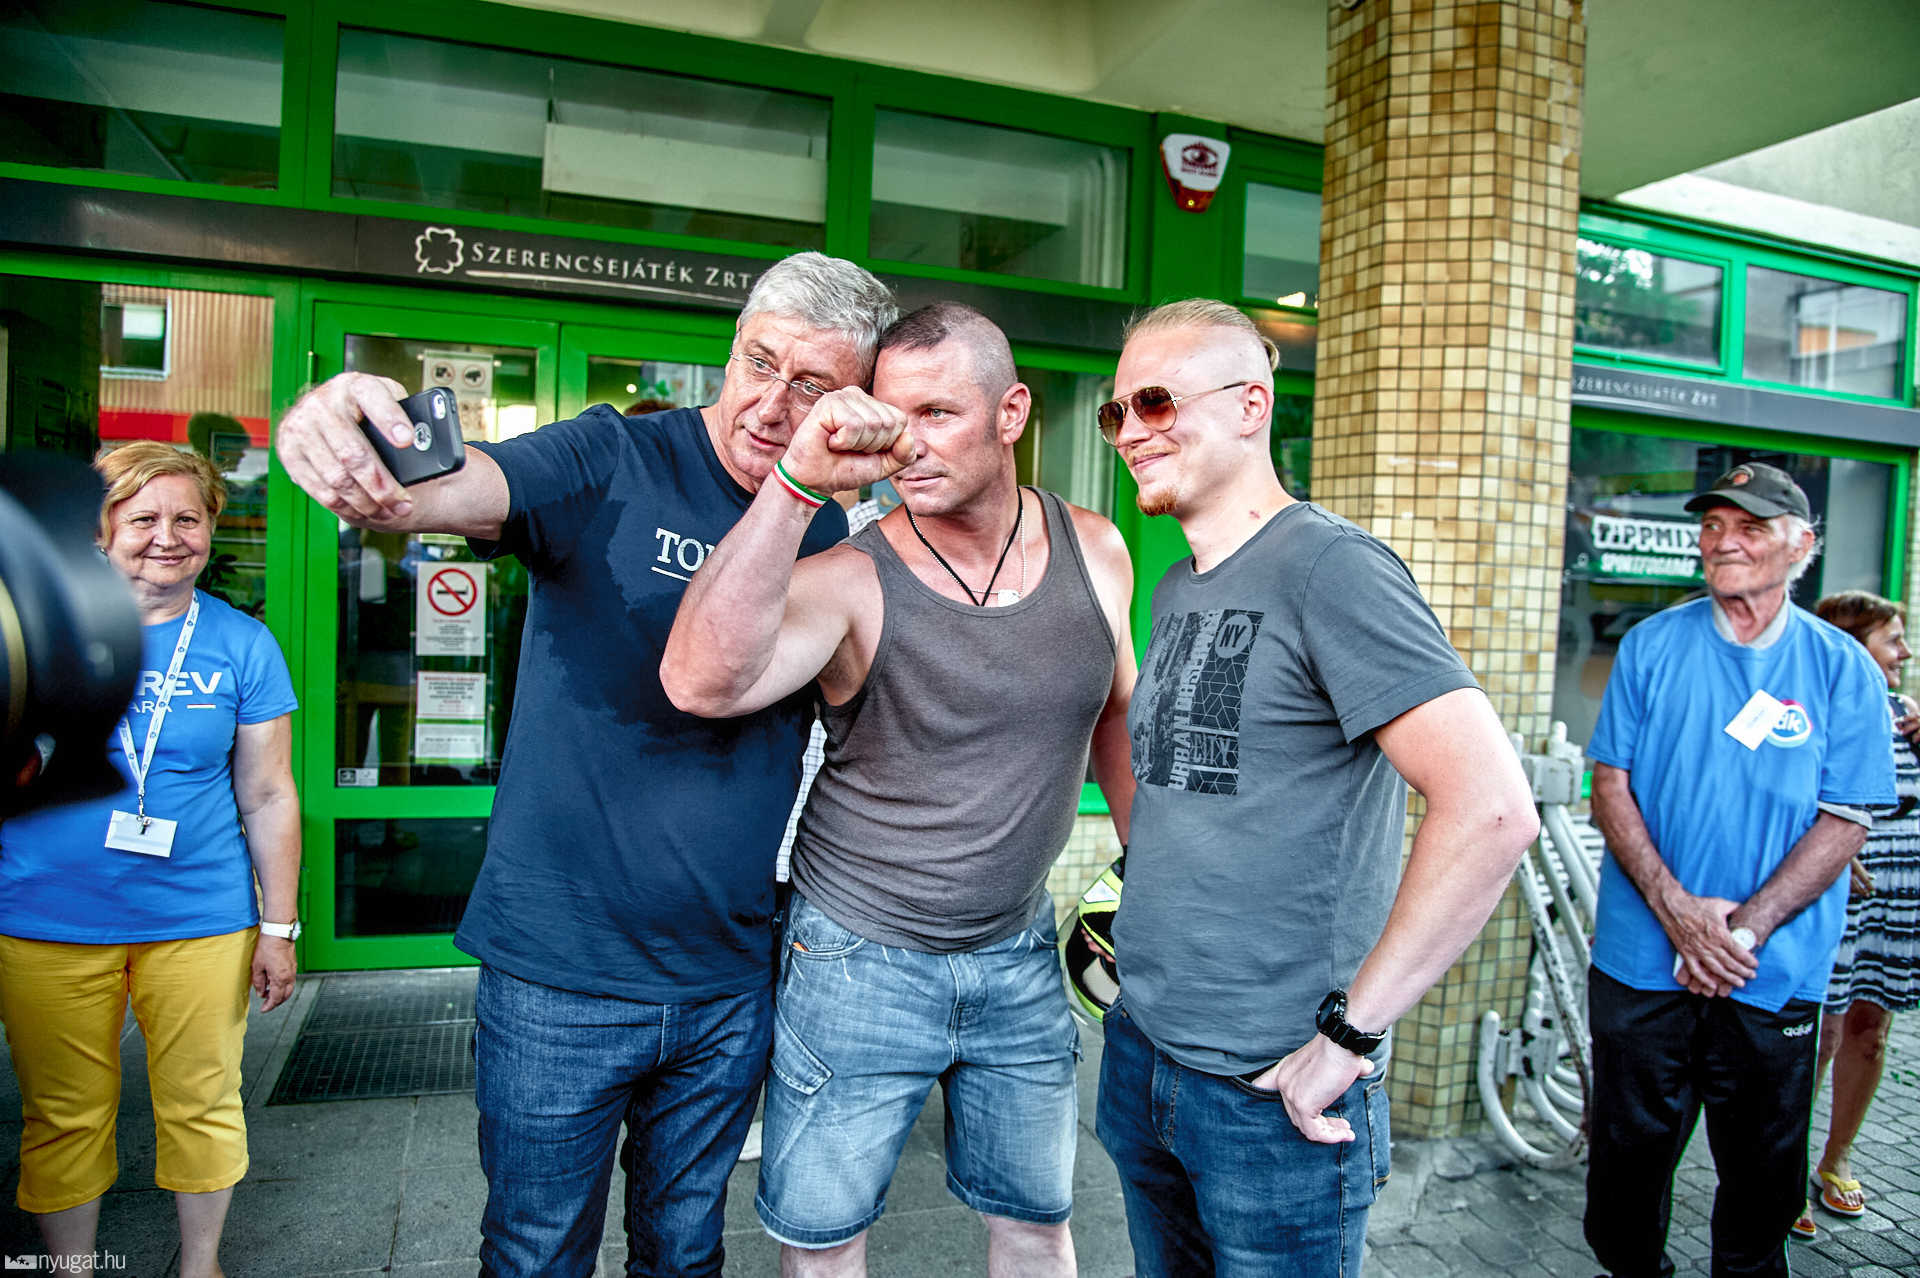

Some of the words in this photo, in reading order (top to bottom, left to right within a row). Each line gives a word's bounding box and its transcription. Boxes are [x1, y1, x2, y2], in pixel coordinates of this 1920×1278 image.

[471, 243, 694, 284] SZERENCSEJÁTÉK
[656, 527, 715, 572] TO
[1218, 623, 1248, 648] NY
